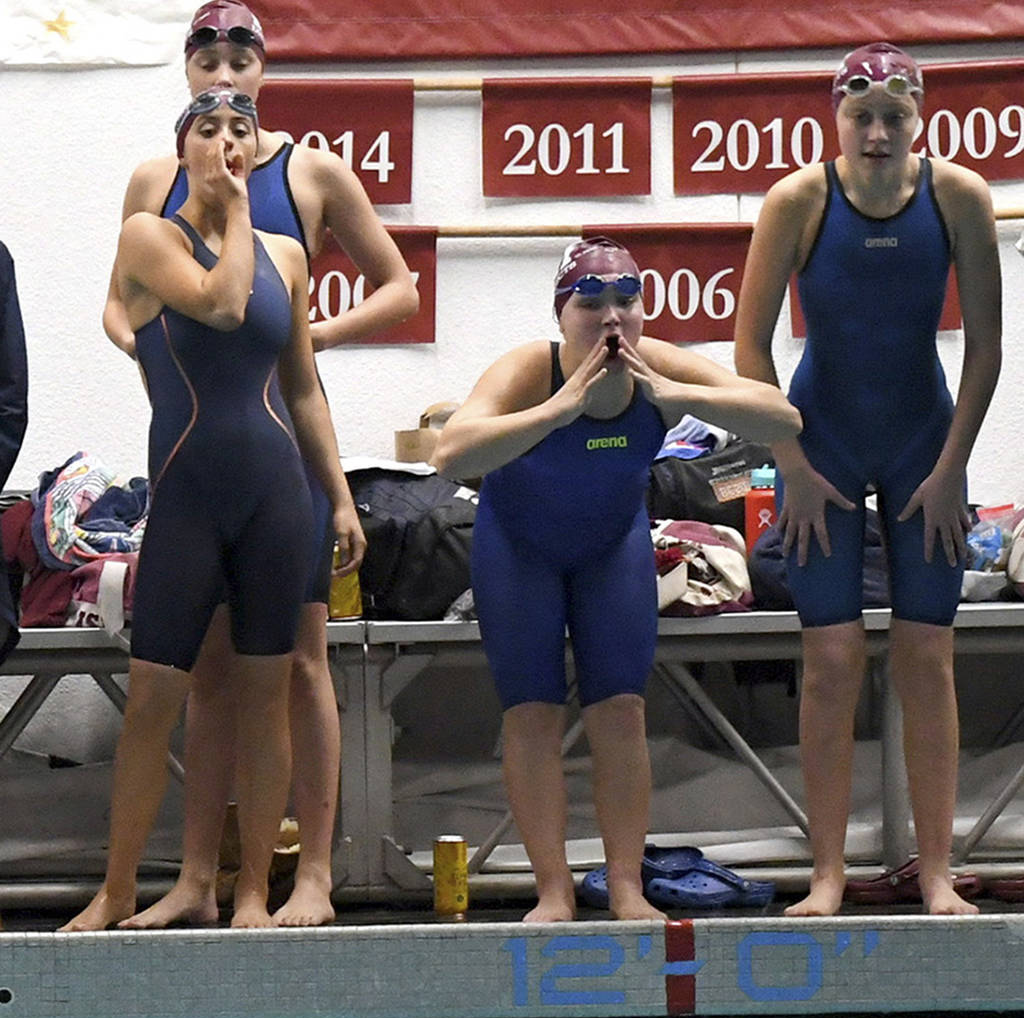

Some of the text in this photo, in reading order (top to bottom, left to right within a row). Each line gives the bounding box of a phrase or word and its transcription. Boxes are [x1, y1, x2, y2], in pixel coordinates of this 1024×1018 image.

[502, 122, 630, 175] 2011
[690, 117, 824, 172] 2010
[639, 267, 736, 320] 006
[586, 435, 628, 450] arena
